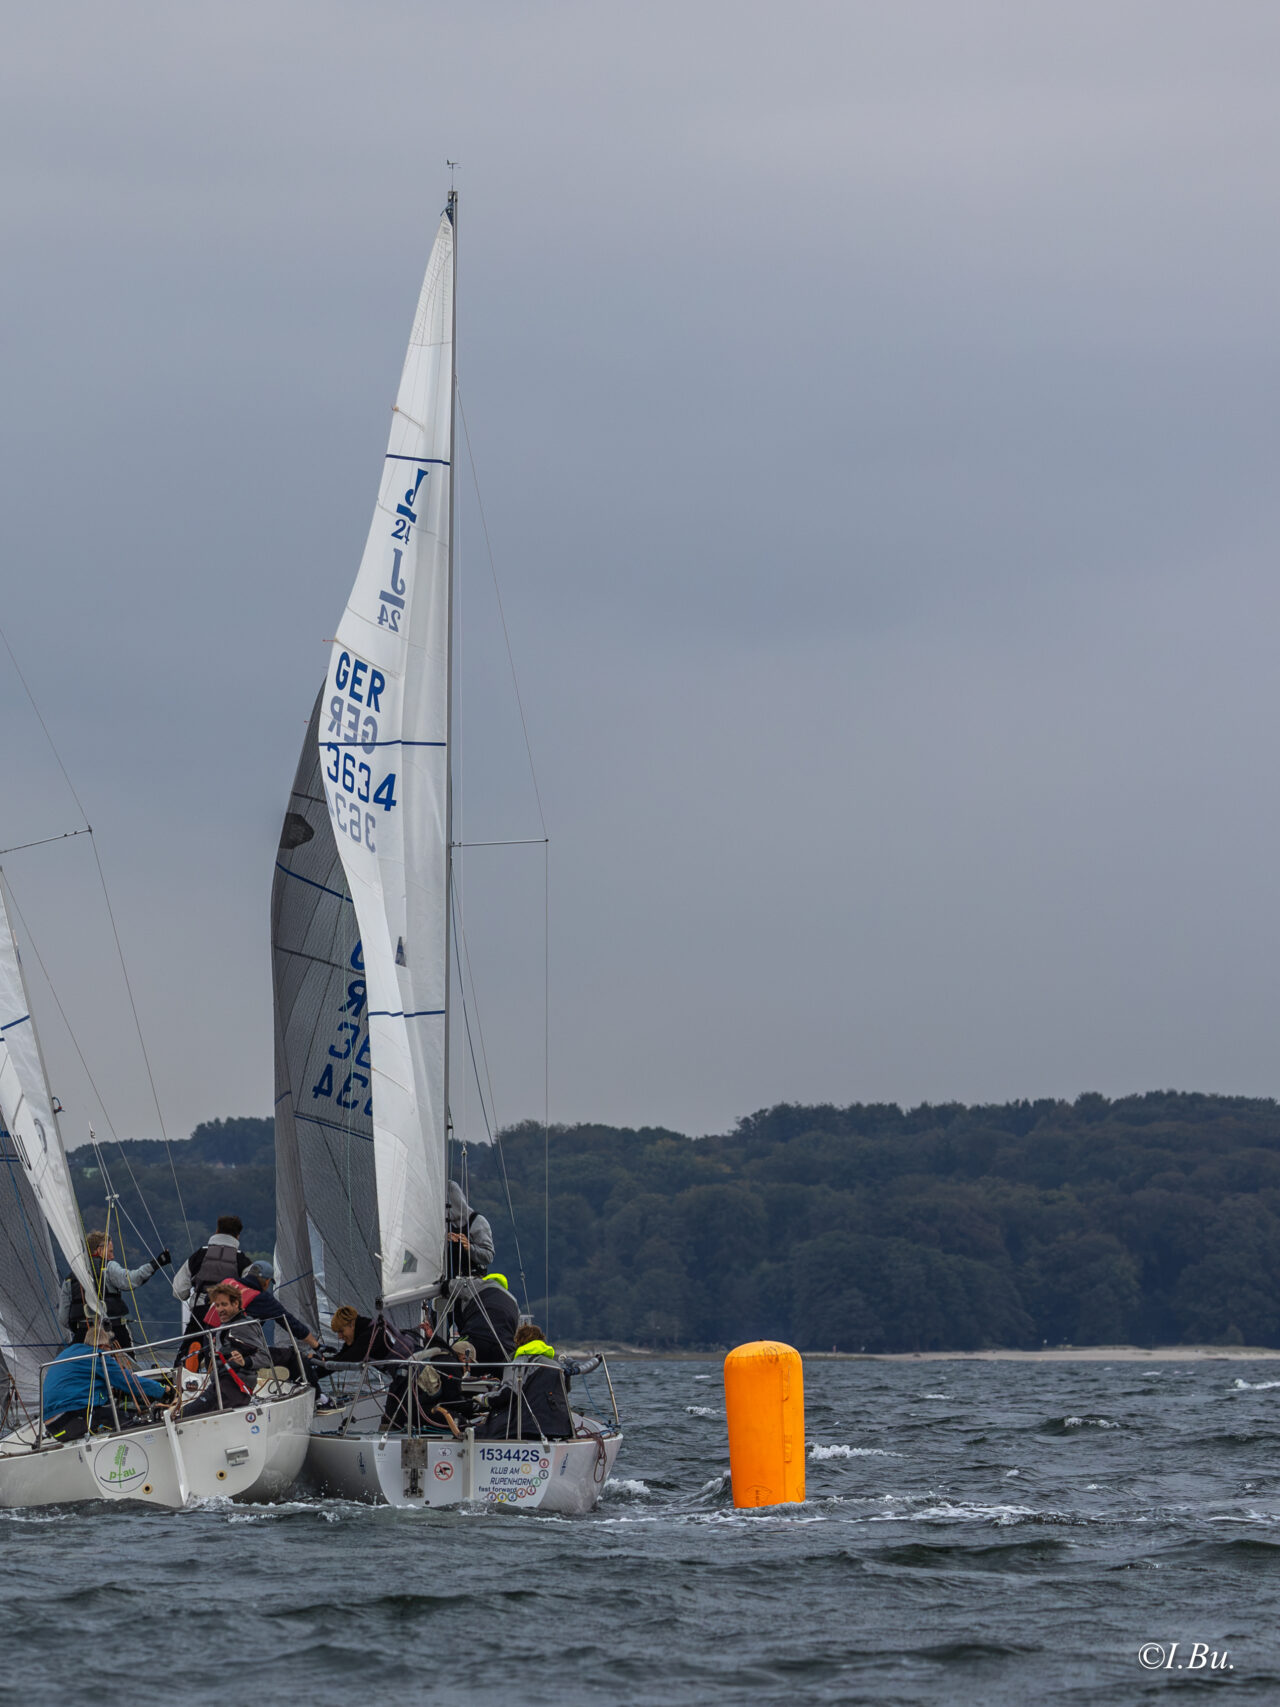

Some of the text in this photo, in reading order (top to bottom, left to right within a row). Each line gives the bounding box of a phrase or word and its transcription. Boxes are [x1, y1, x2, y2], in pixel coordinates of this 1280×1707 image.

[391, 518, 411, 545] 24
[335, 651, 386, 713] GER
[326, 741, 397, 812] 3634
[479, 1448, 540, 1462] 153442S
[490, 1466, 520, 1475] KLUB AM
[490, 1477, 533, 1486] RUPENHORN
